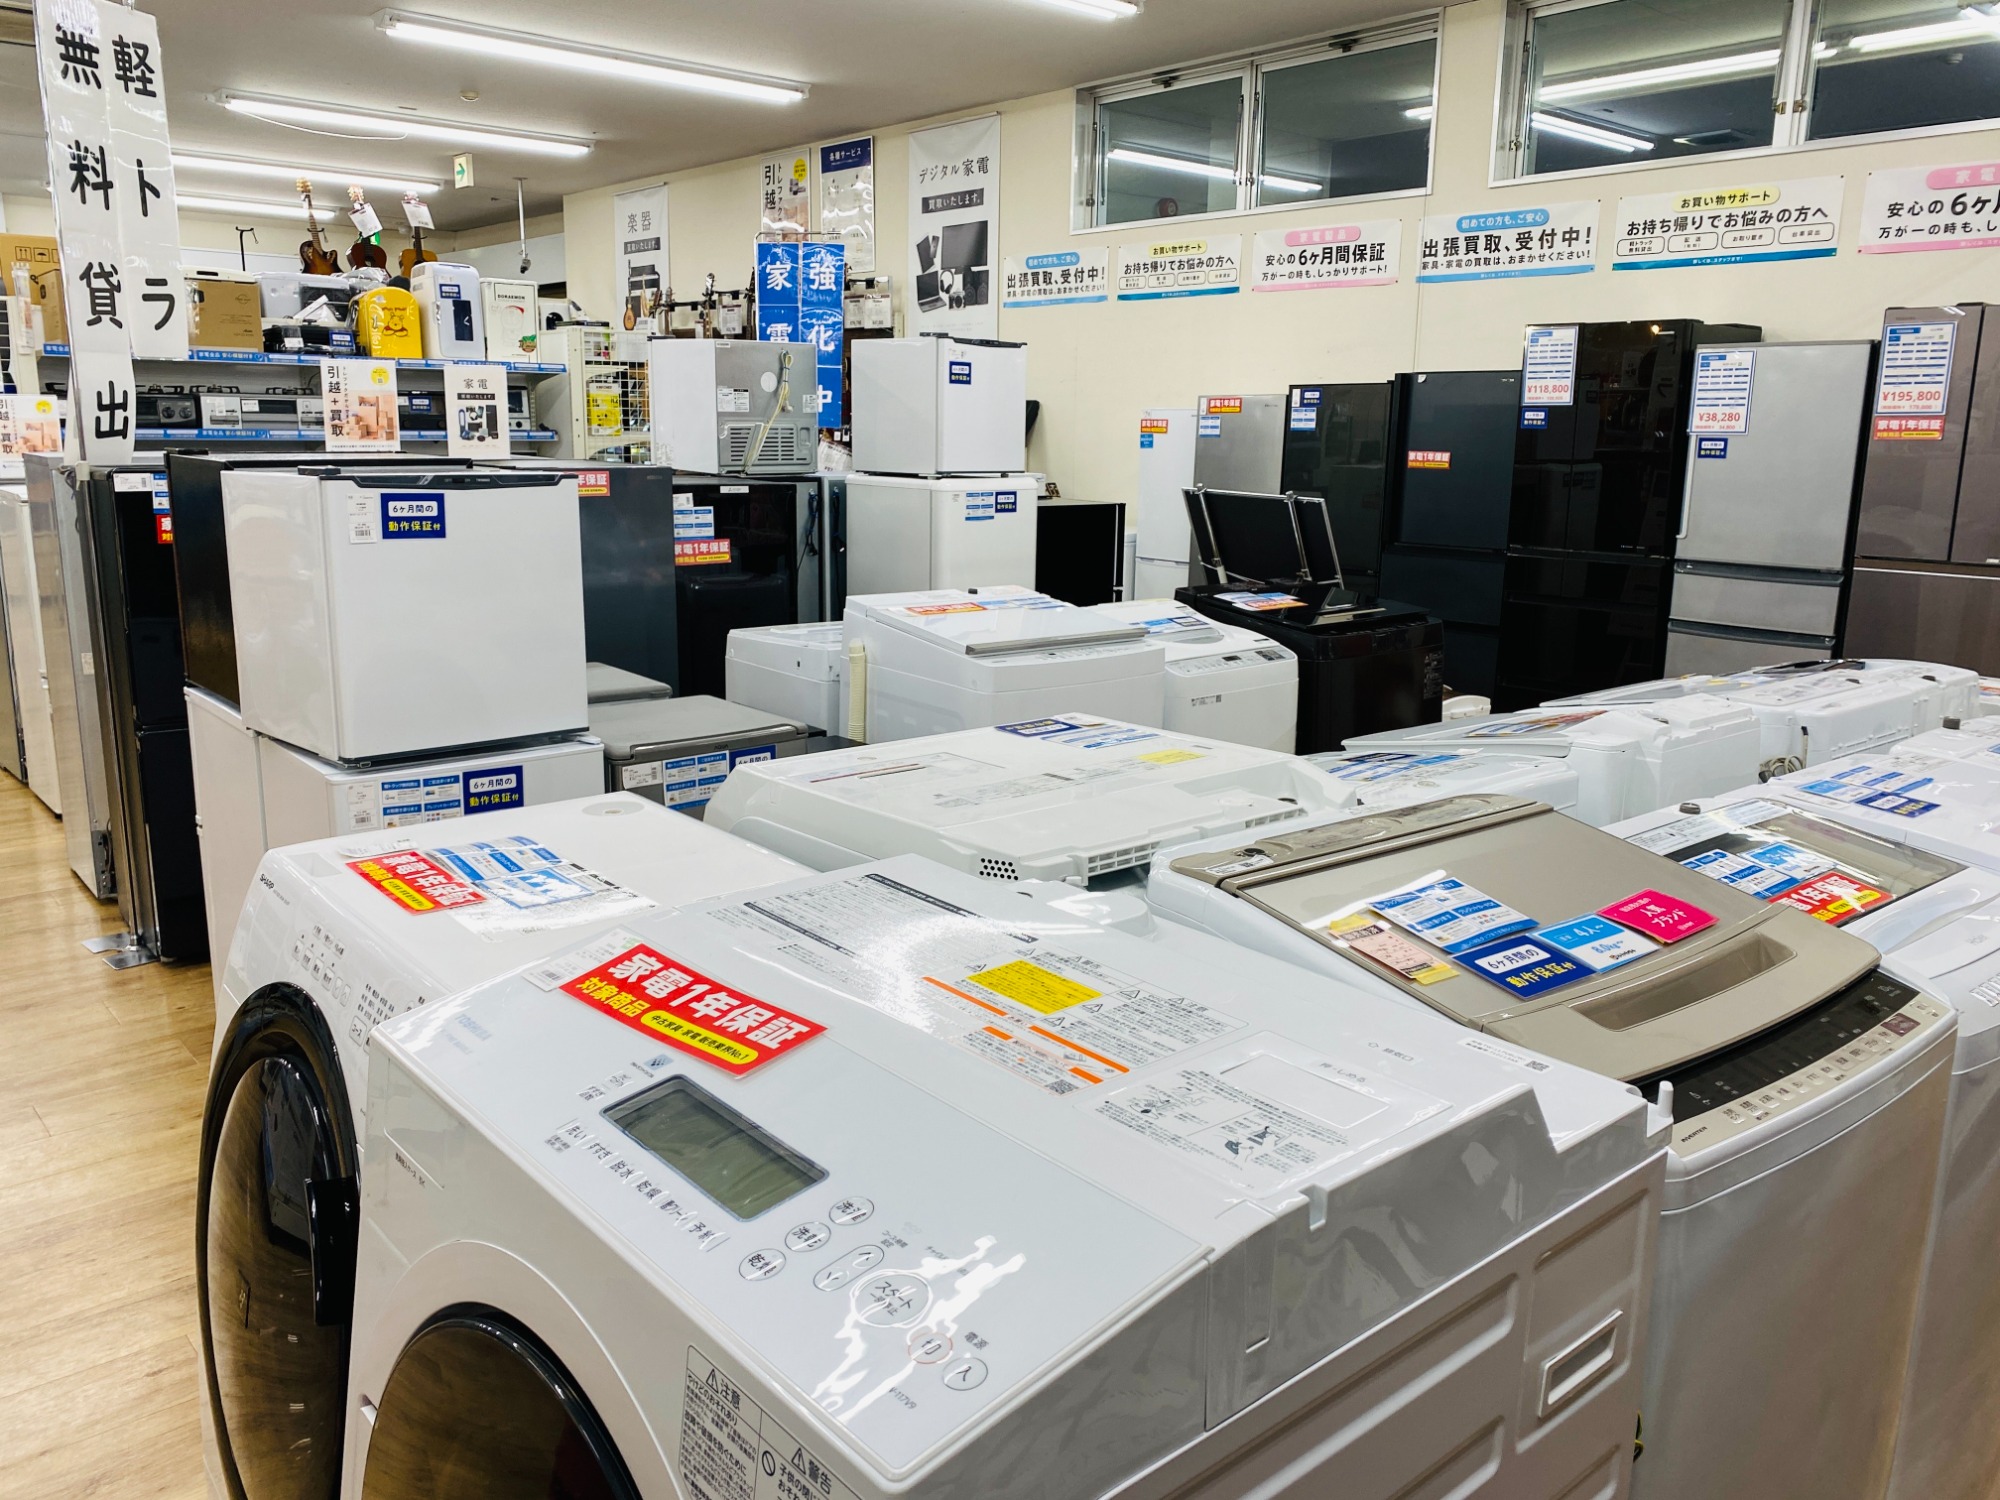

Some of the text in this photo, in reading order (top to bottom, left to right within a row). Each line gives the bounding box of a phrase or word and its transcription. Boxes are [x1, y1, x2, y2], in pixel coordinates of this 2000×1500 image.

[919, 156, 990, 184] デジタル家電
[112, 34, 176, 330] 軽トラ
[764, 164, 777, 211] 引越
[1680, 190, 1771, 209] お買い物サポート
[628, 211, 652, 234] 楽器
[1462, 212, 1544, 229] 初めての方も、ご安心
[1627, 206, 1828, 237] お持ち帰りでお悩みの方へ
[55, 24, 129, 440] 無料貸出
[1152, 243, 1203, 256] お買い物サポート
[1265, 243, 1386, 267] 安心の6ヶ月間保証
[1124, 254, 1235, 275] お持ち帰りでお悩みの方へ
[808, 262, 837, 413] 強化中
[463, 378, 489, 390] 家電
[1882, 391, 1942, 402] ¥195,800
[1698, 412, 1741, 424] ¥38,280
[393, 504, 434, 514] 6ヶ月間の
[388, 521, 441, 532] 動作保証付
[474, 778, 513, 790] 6ヶ月間の
[469, 793, 519, 807] 動作保証付
[259, 873, 274, 889] SHARP
[381, 855, 477, 907] 家電1年保証
[1651, 908, 1687, 928] ブランド
[1487, 948, 1539, 970] 6ヶ月間の
[1505, 961, 1577, 988] 動作保証付
[575, 976, 652, 1018] 対象商品
[607, 952, 812, 1050] 家電1年保証
[565, 1125, 587, 1140] 洗い
[1680, 1126, 1708, 1143] INVERTER
[609, 1159, 634, 1180] 脱水
[636, 1179, 662, 1198] 乾燥
[875, 1281, 913, 1309] スタート
[920, 1338, 942, 1355] 切
[963, 1331, 990, 1351] 電源
[954, 1364, 974, 1383] 入
[720, 1378, 741, 1412] 注意
[808, 1458, 832, 1495] 警告
